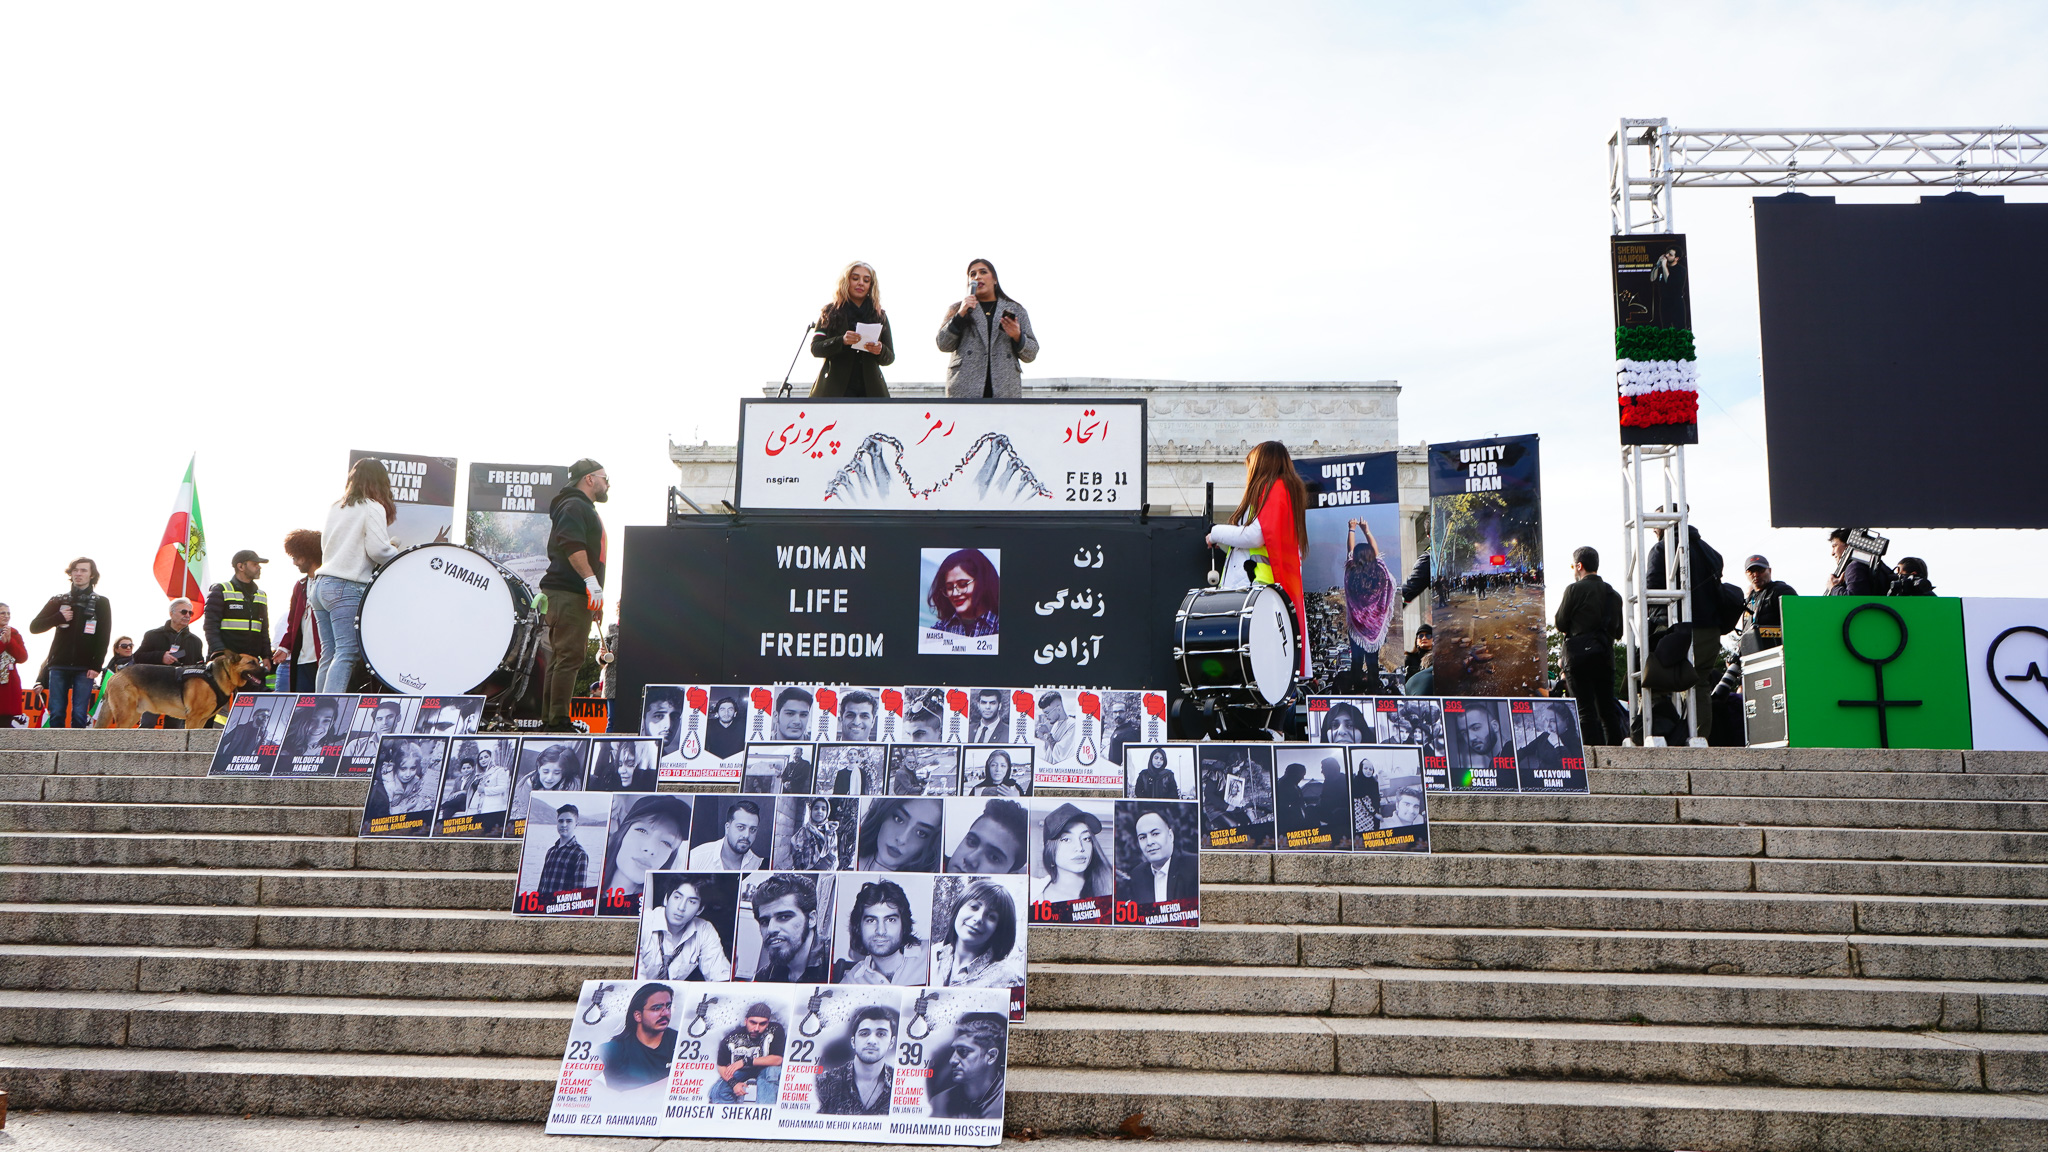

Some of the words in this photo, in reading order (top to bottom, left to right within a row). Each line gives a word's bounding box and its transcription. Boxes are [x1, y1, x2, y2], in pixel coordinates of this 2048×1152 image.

[1618, 246, 1646, 254] SHERVIN
[916, 412, 955, 446] رمز
[1062, 409, 1108, 444] اتحاد
[765, 411, 841, 459] پیروزی
[1460, 445, 1506, 464] UNITY
[1322, 462, 1366, 478] UNITY
[1469, 462, 1498, 478] FOR
[488, 470, 552, 486] FREEDOM
[766, 476, 800, 485] nsgiran
[1066, 472, 1102, 485] FEB
[1115, 472, 1128, 485] 11
[1336, 477, 1351, 491] IS
[1466, 476, 1502, 492] IRAN
[506, 485, 533, 498] FOR
[1066, 488, 1117, 502] 2023
[502, 498, 536, 511] IRAN
[1318, 490, 1370, 507] POWER
[776, 546, 866, 570] WOMAN
[1074, 544, 1104, 568] زن
[444, 560, 490, 590] YAMAHA
[790, 589, 848, 613] LIFE
[1034, 588, 1105, 617] زندگی
[1275, 611, 1287, 657] SPL
[760, 632, 884, 657] FREEDOM
[977, 640, 986, 650] 22
[1034, 635, 1104, 666] آزادی
[238, 696, 254, 704] SOS
[424, 698, 440, 706] SOS
[1311, 700, 1327, 708] SOS
[1378, 700, 1394, 708] SOS
[1446, 701, 1462, 709] SOS
[1513, 702, 1530, 710] SOS
[257, 745, 280, 755] FREE
[687, 740, 695, 748] 21
[1083, 746, 1090, 754] 18
[320, 746, 343, 756] FREE
[292, 756, 325, 764] NILOUFAR
[1425, 756, 1447, 768] FREE
[1493, 757, 1515, 769] FREE
[1562, 758, 1584, 770] FREE
[293, 764, 319, 772] HAMEDI
[1470, 769, 1497, 777] TOOMAJ
[1534, 770, 1571, 778] KATAYOUN
[1472, 778, 1497, 787] SALEHI
[1544, 779, 1563, 787] RIAHI
[371, 815, 399, 825] DAUGHTER
[371, 824, 389, 832] KAMAL
[390, 820, 423, 830] AHMADPOUR
[444, 817, 465, 826] MOTHER
[466, 816, 473, 824] OF
[443, 826, 456, 834] KIAN
[457, 823, 482, 832] PIRFALAK
[1210, 829, 1229, 839] SISTER
[1230, 828, 1237, 836] OF
[1286, 830, 1312, 839] PARENTS
[1313, 828, 1319, 837] OF
[1212, 837, 1228, 847] HADIS
[1229, 834, 1248, 845] NAJAFI
[1288, 838, 1306, 848] DONYA
[1307, 834, 1332, 845] FARHADI
[1362, 831, 1385, 841] MOTHER
[1386, 829, 1393, 837] OF
[1364, 838, 1384, 848] POURIA
[1385, 834, 1415, 846] BAKHTIARI
[520, 891, 539, 912] 16
[556, 892, 582, 903] KARVAN
[606, 887, 625, 908] 16
[546, 902, 570, 914] GHADER
[571, 899, 594, 910] SHOKRI
[1032, 900, 1052, 921] 16
[1072, 900, 1096, 912] MAHAK
[1116, 900, 1138, 922] 50
[1160, 903, 1180, 913] MEHDI
[1072, 909, 1101, 921] HASHEMI
[1145, 914, 1169, 925] KARAM
[1169, 910, 1198, 922] ASHTIANI
[568, 1040, 592, 1060] 23
[590, 1054, 599, 1063] yo
[678, 1040, 701, 1060] 23
[700, 1054, 709, 1062] yo
[789, 1040, 814, 1062] 22
[898, 1043, 923, 1066] 39
[565, 1062, 605, 1071] EXECUTED
[676, 1062, 715, 1070] EXECUTED
[786, 1065, 824, 1074] EXECUTED
[562, 1070, 574, 1078] BY
[896, 1068, 934, 1078] EXECUTED
[560, 1078, 593, 1086] ISLAMIC
[783, 1083, 812, 1092] ISLAMIC
[558, 1087, 588, 1095] REGIME
[782, 1093, 809, 1101] REGIME
[894, 1087, 924, 1096] ISLAMIC
[781, 1102, 788, 1110] ON
[893, 1096, 920, 1105] REGIME
[665, 1105, 714, 1118] MOHSEN
[722, 1106, 772, 1120] SHEKARI
[551, 1113, 577, 1124] MAJID
[580, 1114, 602, 1125] REZA
[606, 1115, 658, 1126] RAHNAVARD
[778, 1119, 824, 1129] MOHAMMAD
[826, 1121, 850, 1130] MEHDI
[852, 1121, 882, 1130] KARAMI
[889, 1123, 950, 1136] MOHAMMAD
